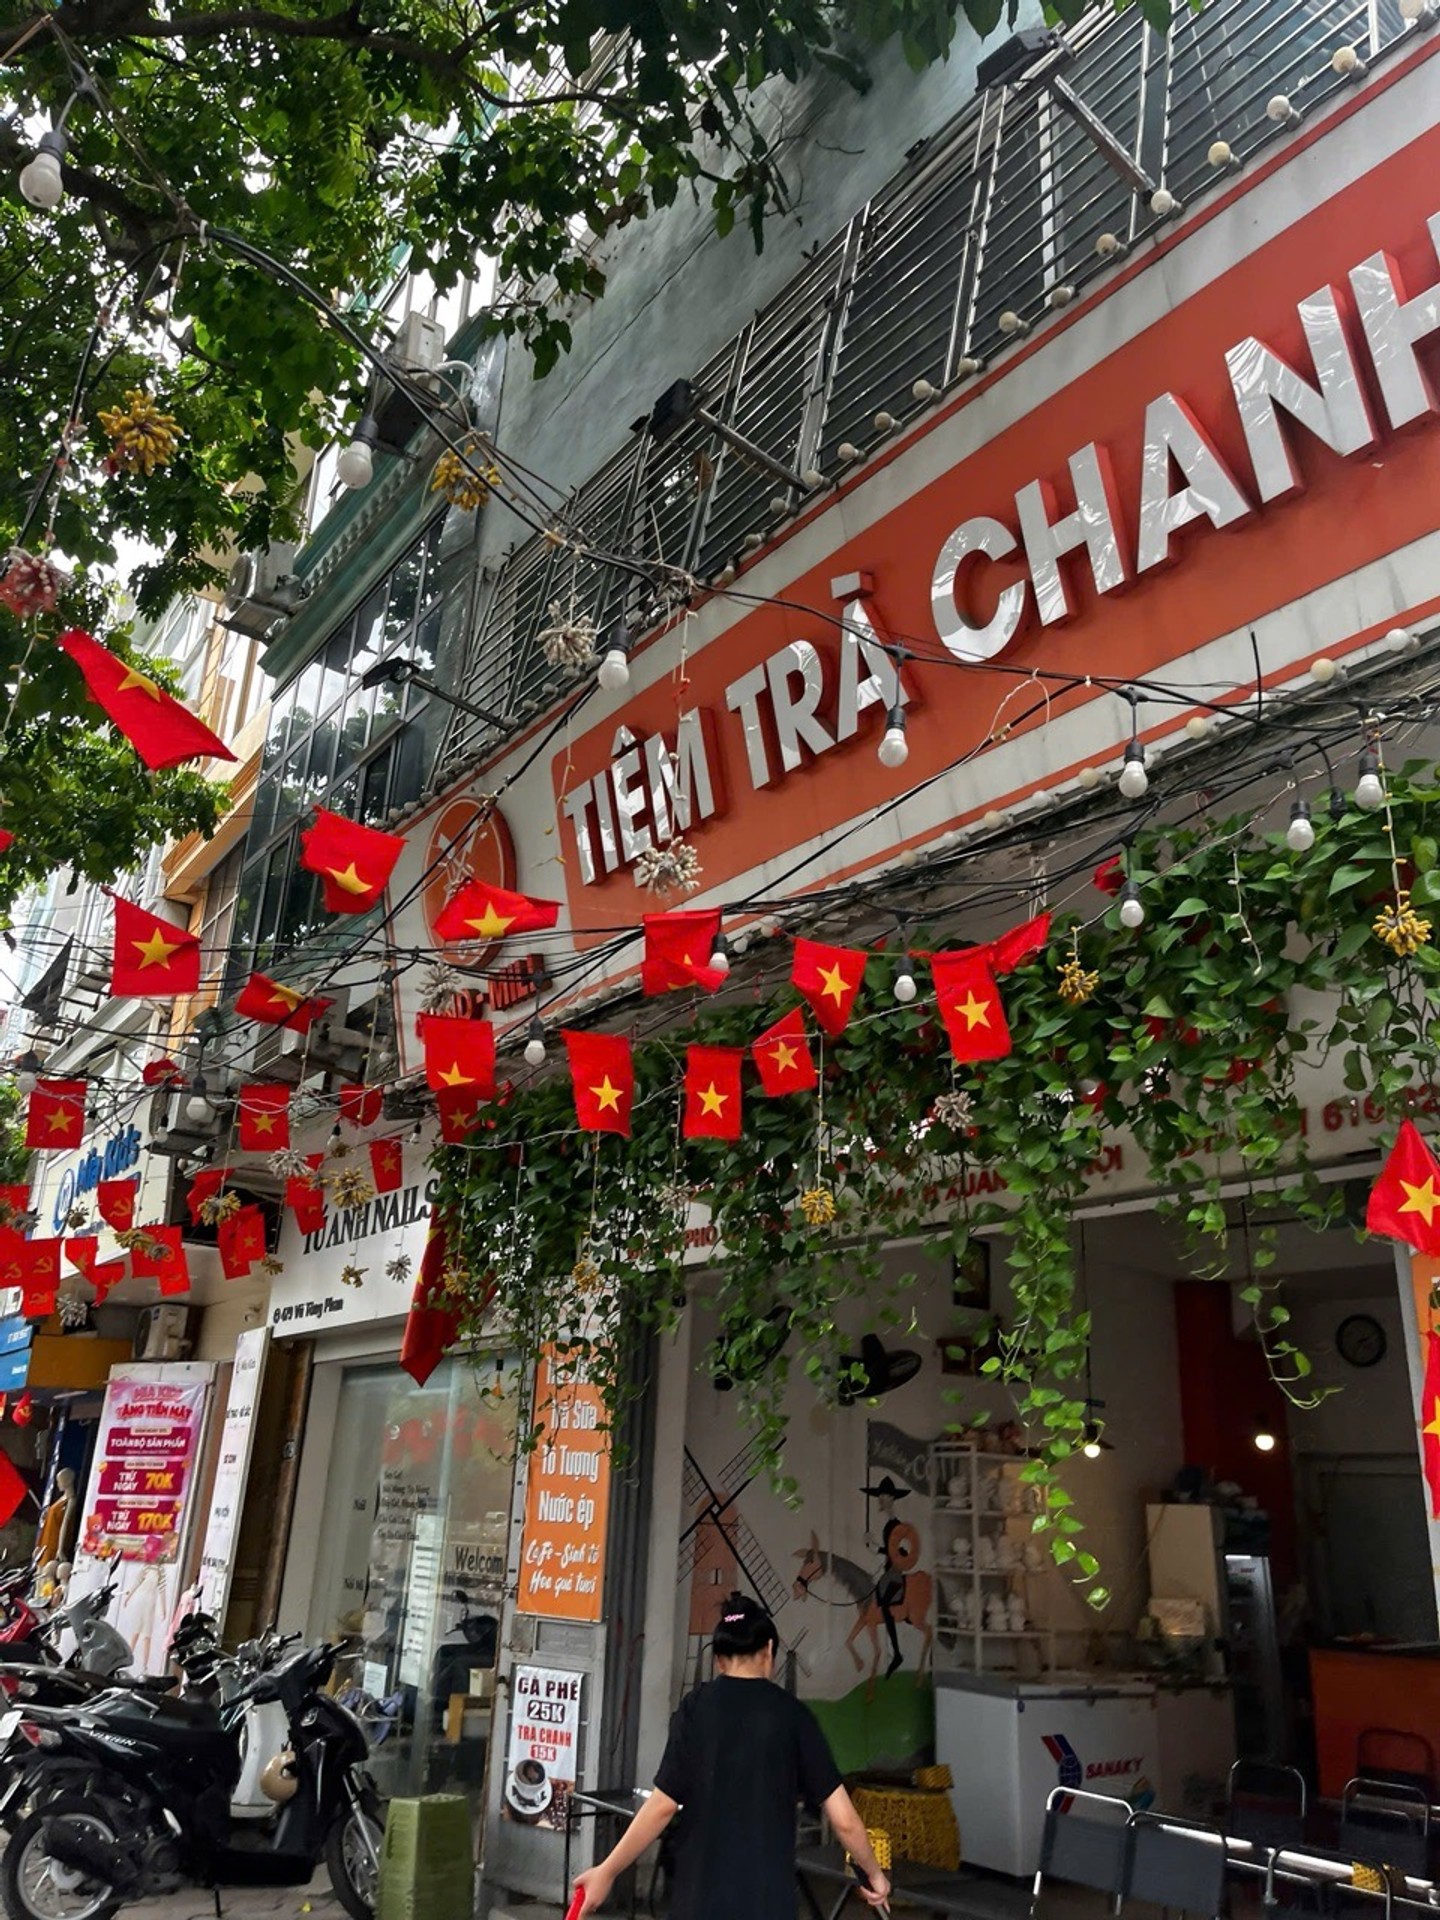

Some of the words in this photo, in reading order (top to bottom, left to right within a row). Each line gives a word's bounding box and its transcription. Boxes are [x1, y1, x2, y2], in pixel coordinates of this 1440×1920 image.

[725, 571, 911, 790] TRÀ
[931, 210, 1440, 662] CHANH
[326, 1200, 371, 1249] ANH
[371, 1178, 440, 1236] NAILS
[323, 1296, 344, 1313] Phan
[572, 1398, 597, 1430] Sữa
[541, 1443, 556, 1476] Tô
[559, 1444, 599, 1484] Tượng
[112, 1481, 139, 1492] NGAY
[144, 1471, 175, 1491] 70K
[137, 1511, 174, 1532] 170K
[537, 1490, 574, 1523] Nước
[576, 1492, 595, 1532] ép
[455, 1546, 505, 1575] Welcom
[529, 1568, 553, 1595] Hoa
[518, 1676, 540, 1695] CÀ
[546, 1680, 578, 1700] PHÊ
[529, 1701, 562, 1721] 25K
[539, 1728, 572, 1746] CHANH
[533, 1746, 556, 1760] 15K
[1085, 1755, 1145, 1780] SANAKY
